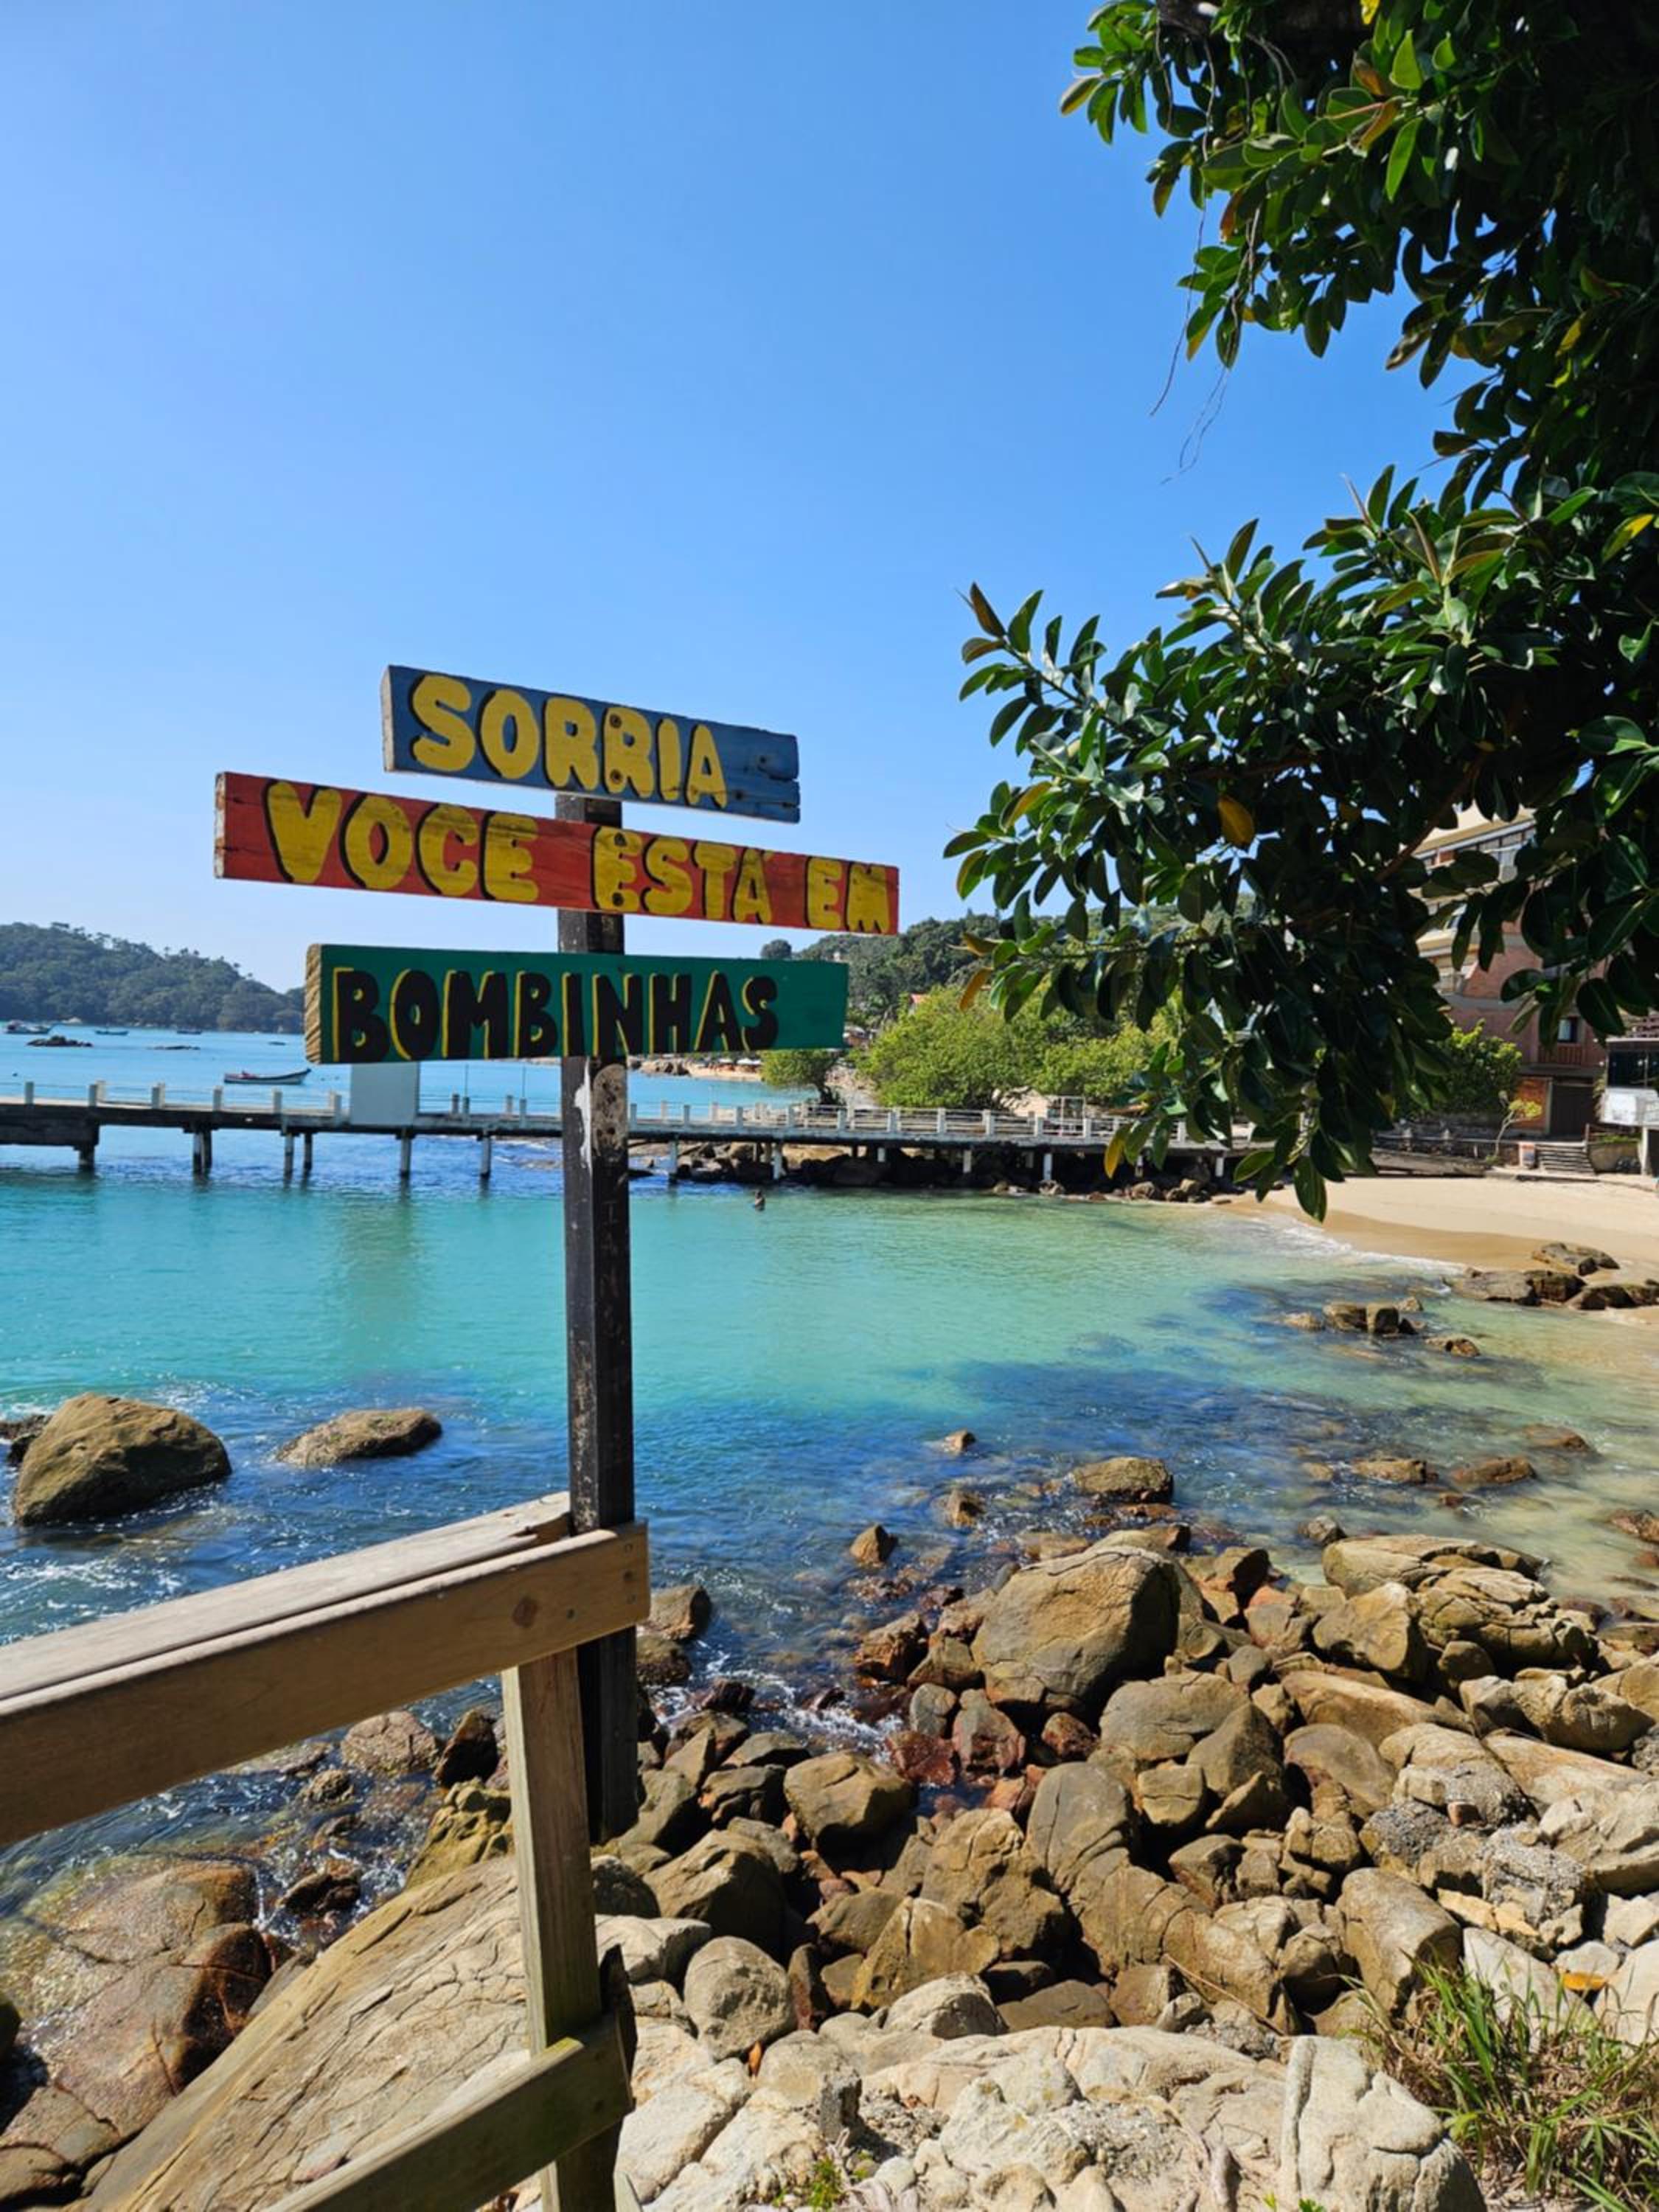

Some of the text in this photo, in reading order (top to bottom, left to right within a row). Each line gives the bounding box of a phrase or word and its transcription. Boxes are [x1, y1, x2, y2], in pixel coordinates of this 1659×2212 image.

[410, 674, 728, 808] SORRIA
[805, 855, 890, 933] EM
[333, 967, 779, 1062] BOMBINHAS
